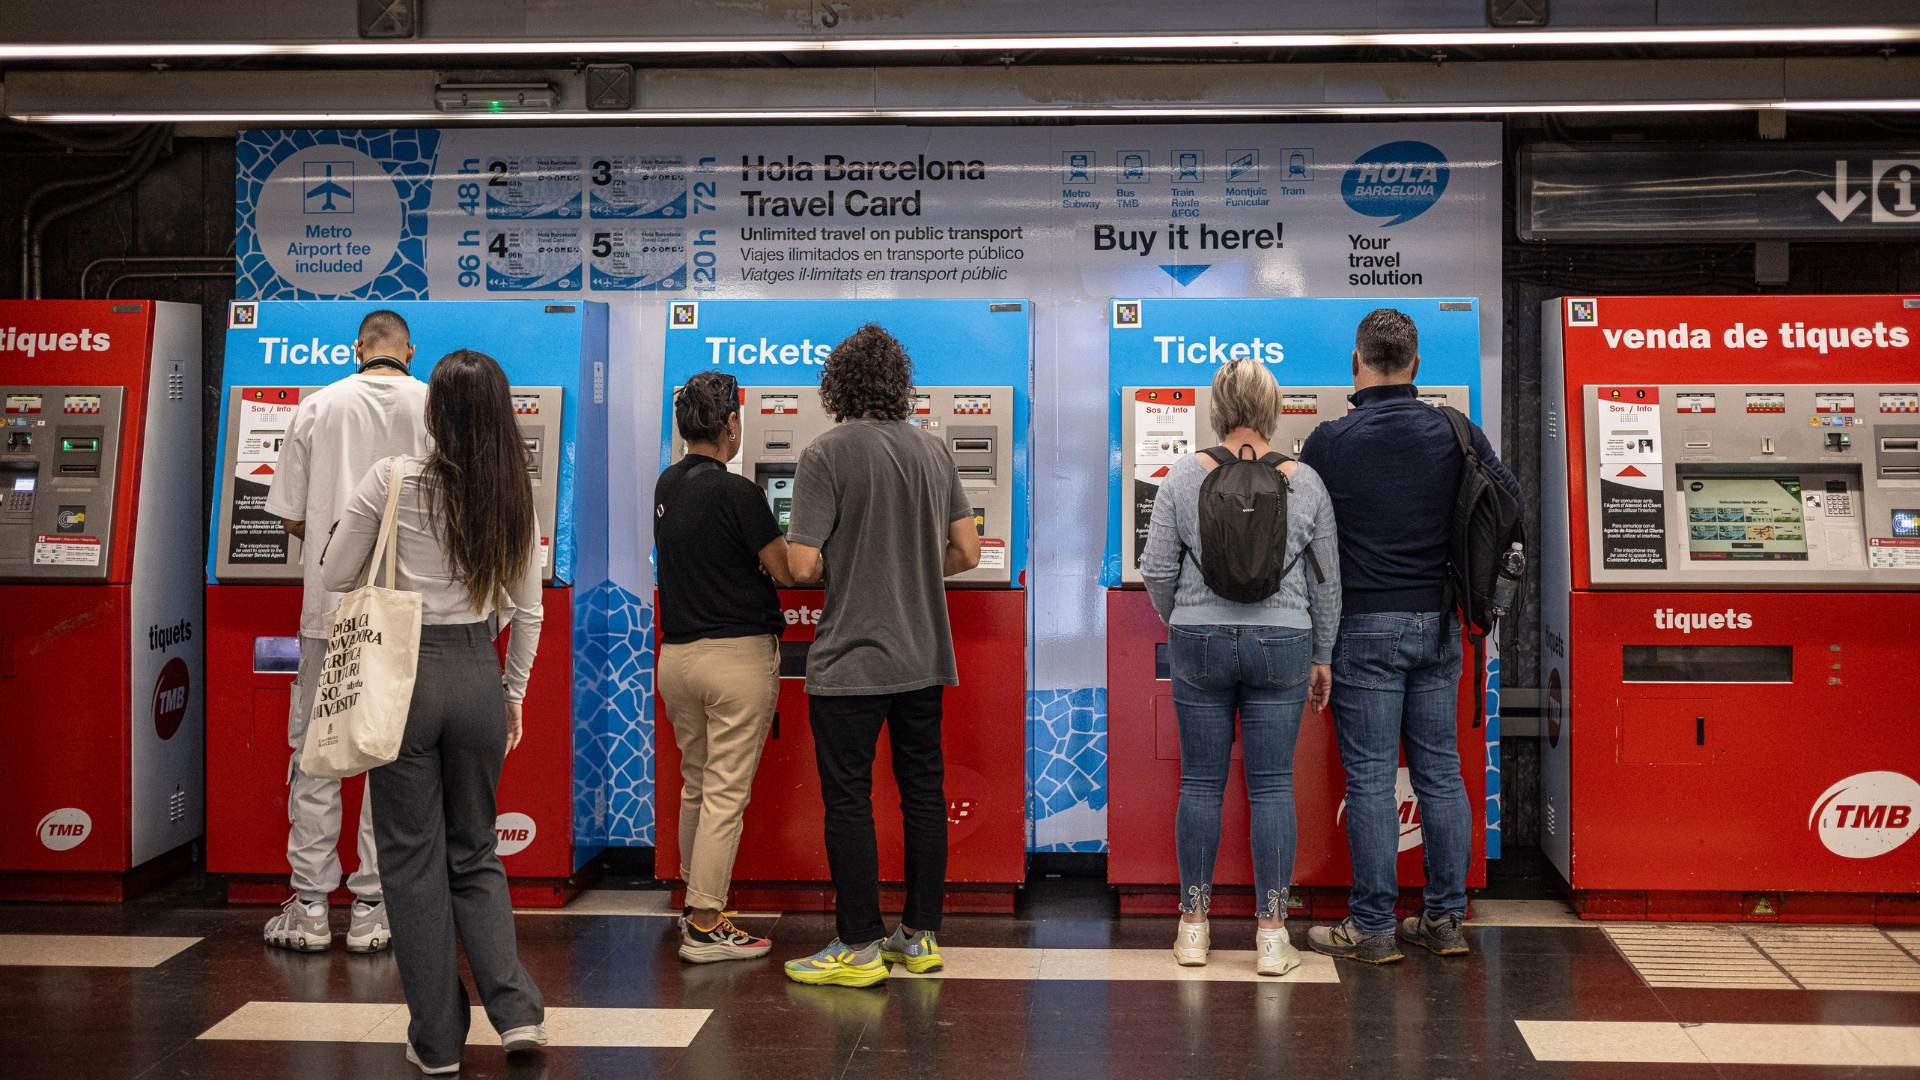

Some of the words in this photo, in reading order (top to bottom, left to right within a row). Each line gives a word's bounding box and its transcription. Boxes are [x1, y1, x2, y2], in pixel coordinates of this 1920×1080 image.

[458, 159, 480, 174] h
[489, 161, 507, 187] 2
[592, 161, 612, 186] 3
[742, 154, 813, 182] Hola
[824, 154, 985, 181] Barcelona
[1356, 162, 1437, 185] HOLA
[694, 182, 716, 214] 72
[1062, 189, 1091, 198] Metro
[1116, 189, 1135, 198] Bus
[1171, 188, 1195, 197] Train
[1225, 187, 1268, 199] Montjuïc
[1281, 187, 1305, 196] Tram
[1355, 185, 1435, 196] BARCELONA
[458, 183, 480, 216] 48
[741, 191, 834, 217] Travel
[845, 190, 921, 216] Card
[1062, 200, 1100, 210] Subway
[1117, 200, 1139, 208] TMB
[1171, 199, 1200, 208] Renfe
[1225, 198, 1269, 207] Funicular
[1171, 208, 1200, 218] &FGC
[306, 225, 352, 238] Metro
[458, 230, 480, 246] h
[694, 230, 716, 245] h
[741, 227, 816, 241] Unlimited
[821, 227, 865, 241] travel
[870, 230, 891, 240] on
[895, 227, 944, 244] public
[947, 226, 1023, 243] transport
[1094, 224, 1157, 256] Buy
[1168, 223, 1188, 250] it
[1200, 222, 1284, 250] here!
[489, 233, 508, 258] 4
[592, 233, 612, 258] 5
[1349, 235, 1391, 250] Your
[287, 242, 342, 260] Airport
[346, 242, 371, 256] fee
[741, 248, 784, 262] Viajes
[788, 247, 860, 261] ilimitados
[864, 251, 882, 261] en
[887, 248, 964, 263] transporte
[969, 247, 1024, 263] público
[296, 259, 363, 273] included
[1349, 252, 1400, 268] travel
[458, 255, 480, 287] 96
[741, 268, 794, 284] Viatges
[867, 271, 885, 281] en
[890, 268, 958, 283] transport
[961, 267, 1007, 283] públic
[1349, 270, 1422, 286] solution
[1603, 323, 1712, 349] venda
[1723, 322, 1768, 349] de
[1779, 322, 1910, 354] tiquets
[705, 337, 832, 365] Tickets
[1153, 336, 1285, 364] Tickets
[1629, 405, 1633, 413] /
[1654, 608, 1753, 633] tiquets
[149, 619, 192, 653] tiquets
[160, 686, 185, 715] TMB
[1835, 805, 1911, 829] TMB
[48, 822, 84, 838] TMB
